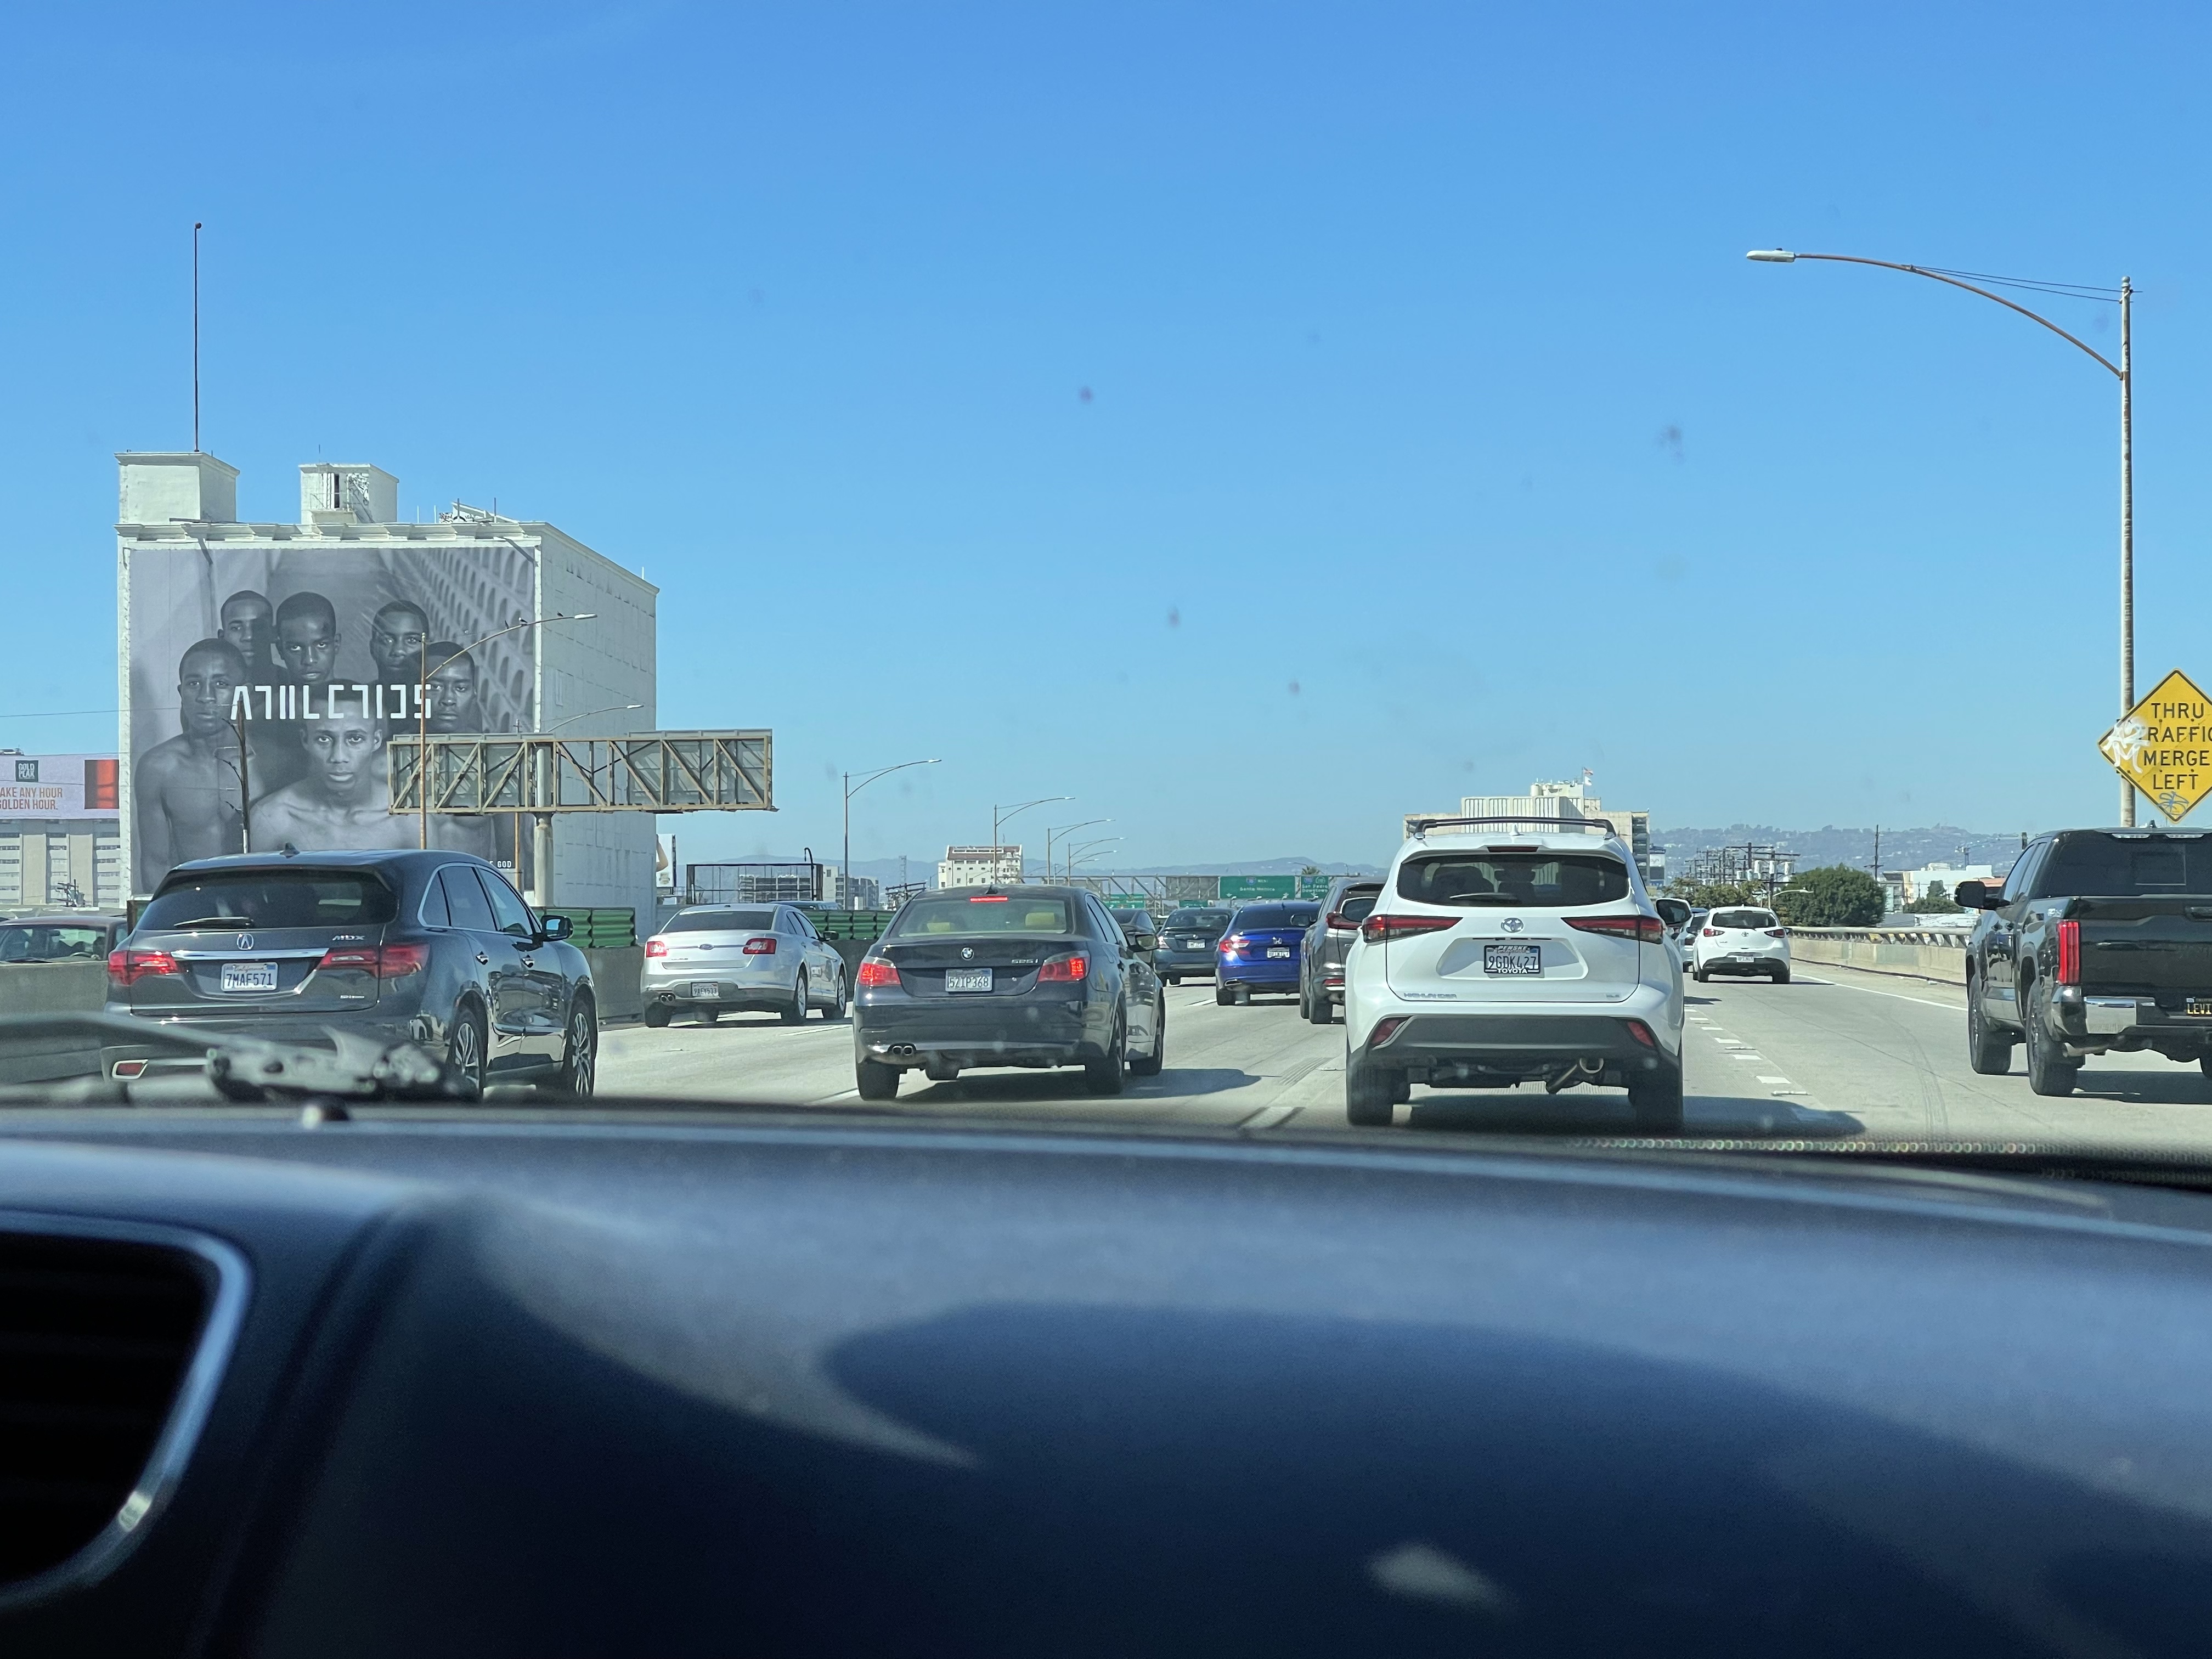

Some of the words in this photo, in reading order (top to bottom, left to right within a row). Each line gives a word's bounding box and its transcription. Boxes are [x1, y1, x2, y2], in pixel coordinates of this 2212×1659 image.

[2151, 702, 2204, 719] THRU
[2136, 726, 2212, 743] RAFFI
[2143, 750, 2210, 766] MERGE
[19, 769, 35, 778] PEAK
[2153, 774, 2199, 790] LEFT
[20, 787, 37, 798] ANY
[39, 787, 63, 798] HOUR
[33, 799, 58, 810] HOUR.
[1487, 956, 1536, 969] 9GDK427
[226, 973, 273, 987] 7MAF571
